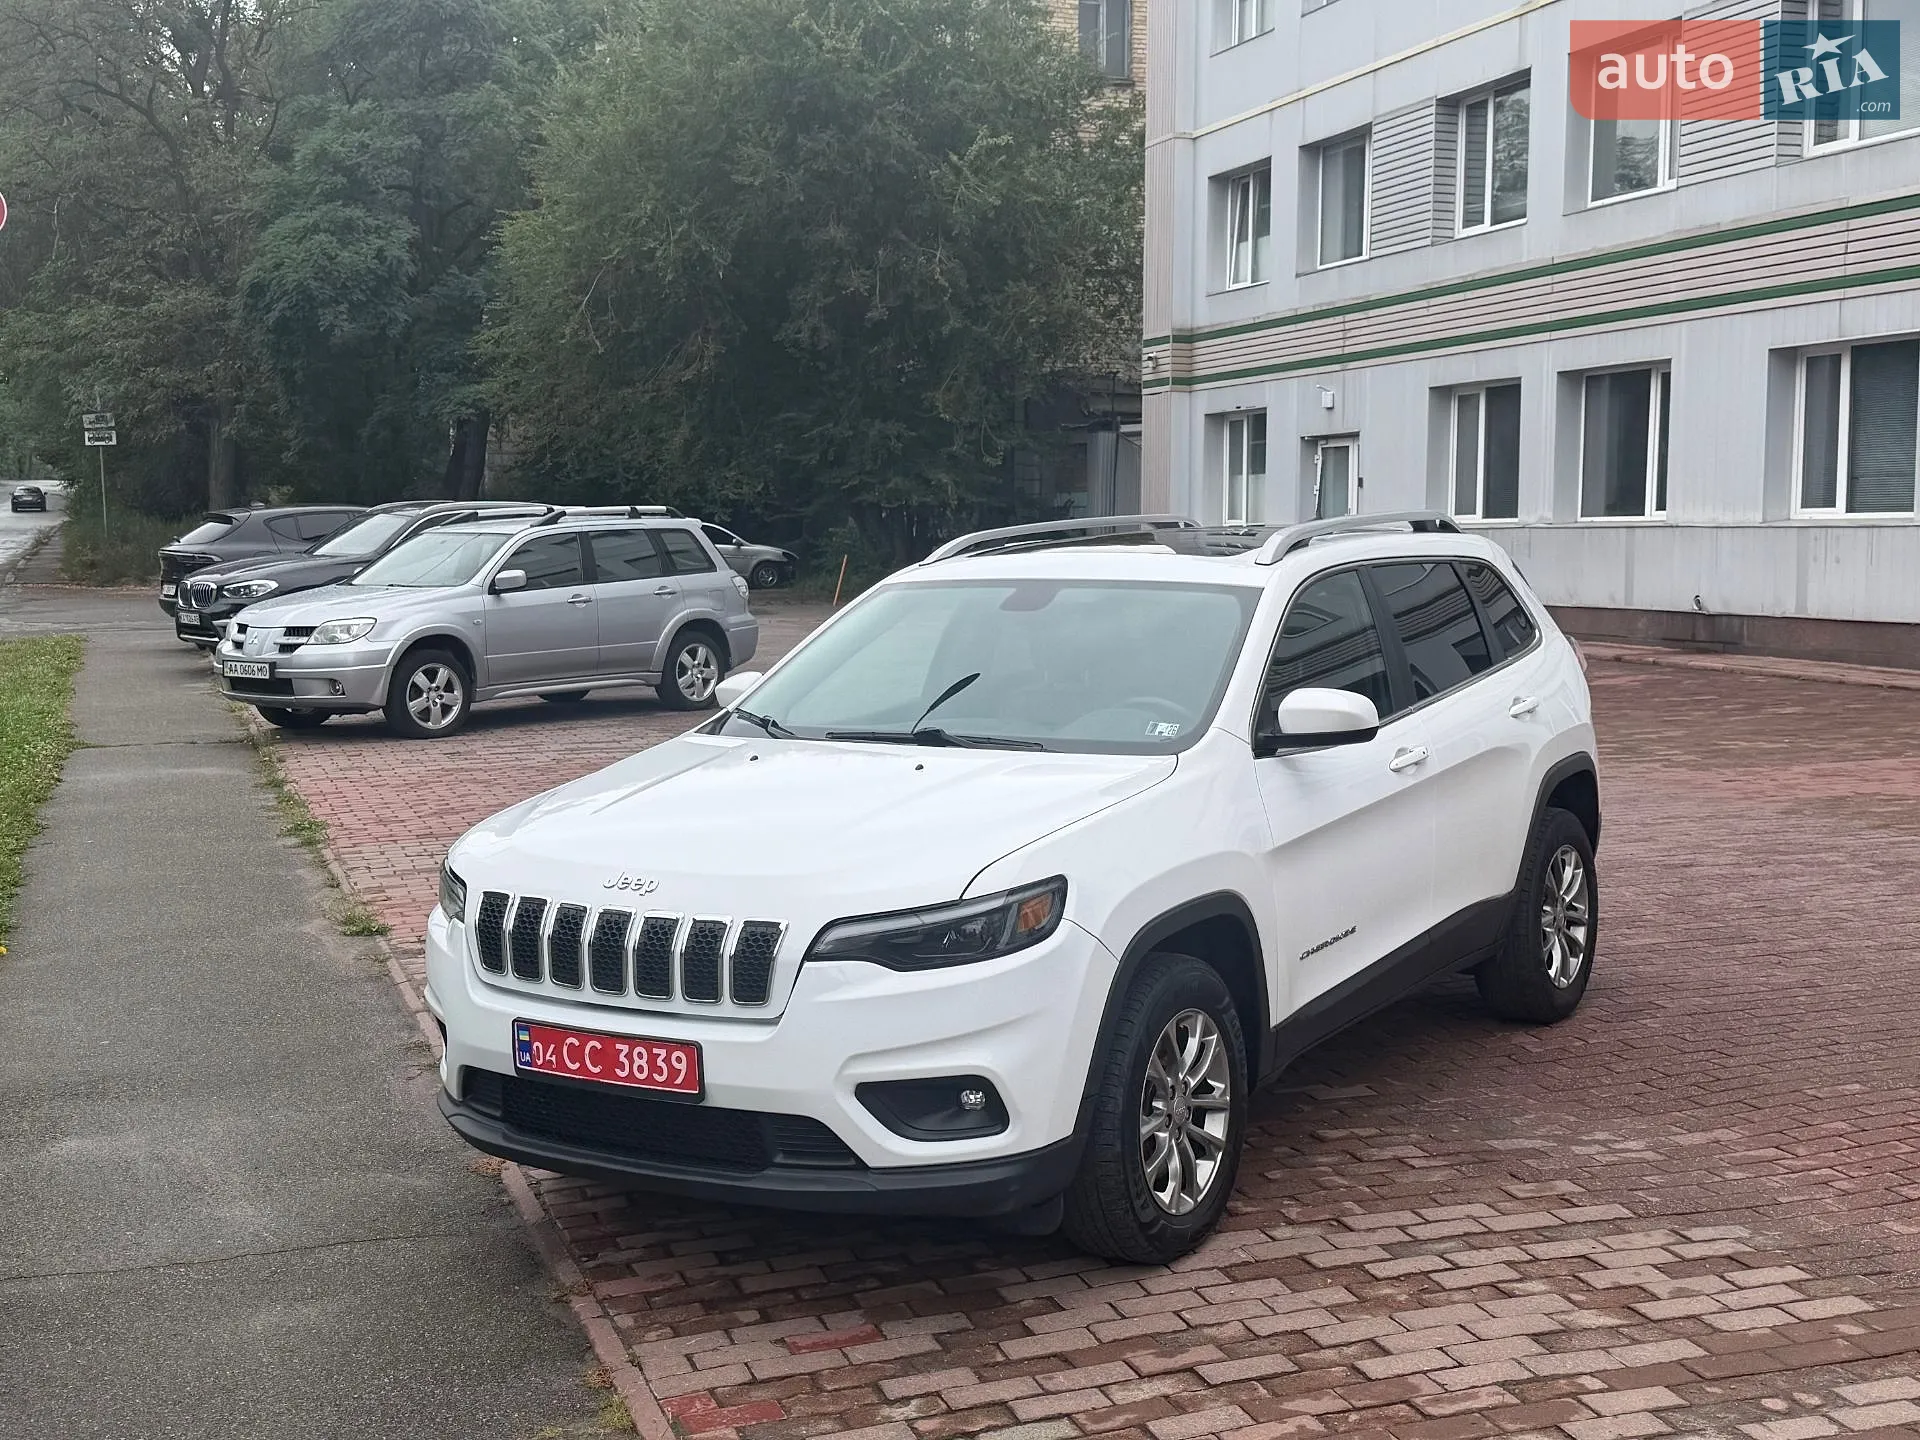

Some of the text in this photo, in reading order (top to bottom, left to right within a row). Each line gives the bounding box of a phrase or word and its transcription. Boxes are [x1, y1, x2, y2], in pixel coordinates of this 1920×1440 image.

[602, 871, 660, 897] Jeep
[519, 1050, 532, 1064] UA
[614, 1043, 687, 1084] 3839
